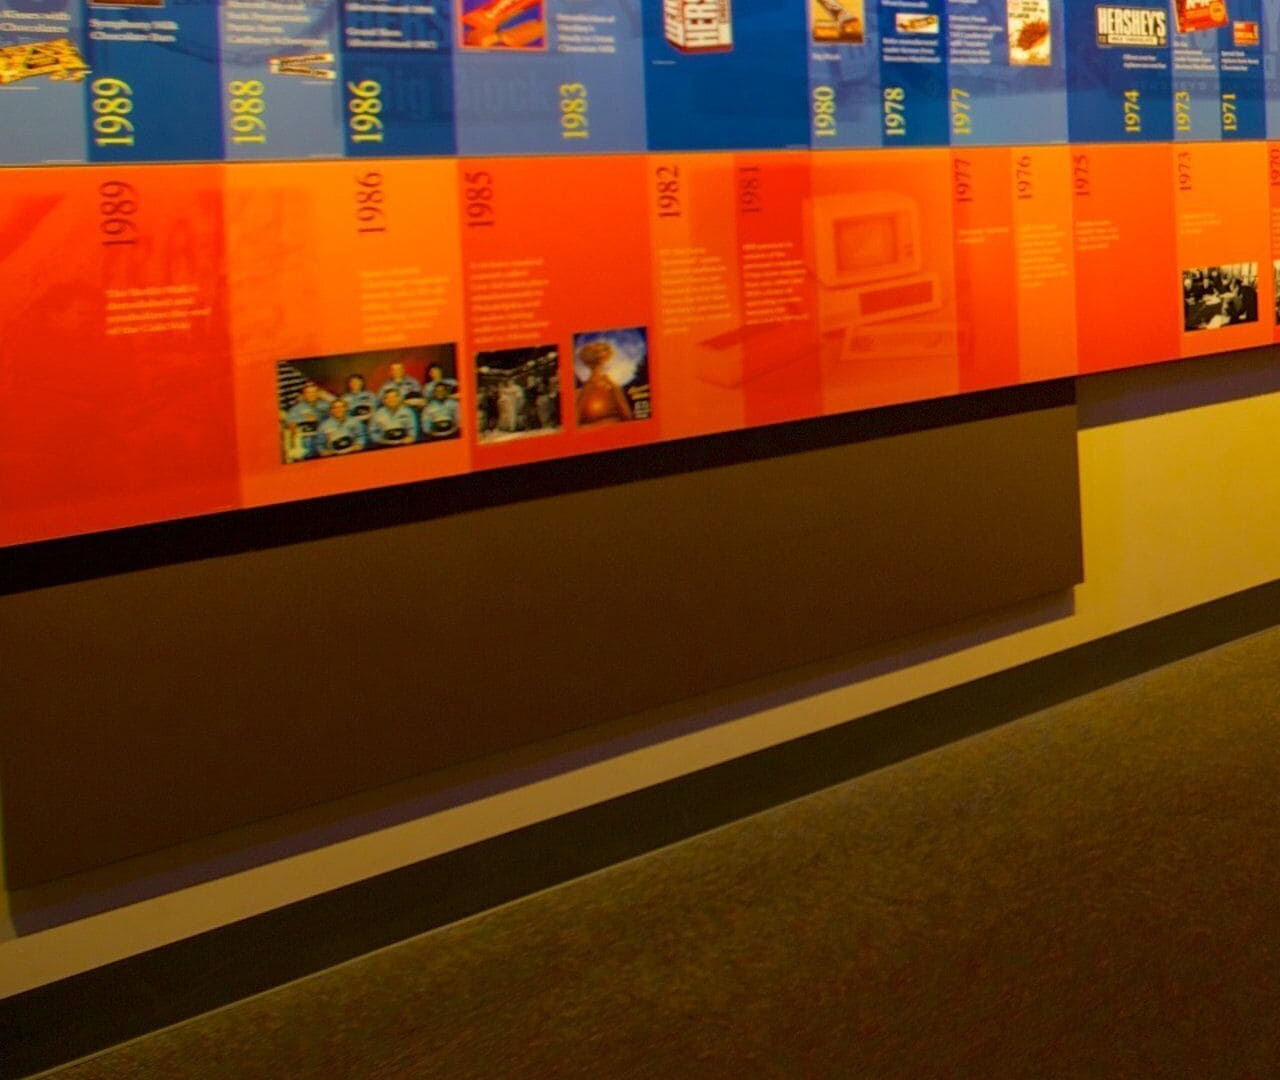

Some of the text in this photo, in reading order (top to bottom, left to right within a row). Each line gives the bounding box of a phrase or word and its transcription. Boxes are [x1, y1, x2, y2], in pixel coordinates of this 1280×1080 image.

[1097, 8, 1166, 37] HERSHEY'S
[92, 77, 134, 147] 1989
[229, 79, 266, 145] 1988
[347, 79, 383, 143] 1986
[560, 82, 589, 139] 1983
[813, 85, 836, 137] 1980
[884, 87, 906, 137] 1978
[952, 88, 971, 134] 1977
[1124, 89, 1141, 133] 1974
[1175, 90, 1192, 133] 1973
[1222, 93, 1237, 132] 1971
[656, 165, 682, 219] 1982
[740, 165, 761, 215] 1981
[955, 158, 972, 203] 1977
[1017, 155, 1033, 201] 1976
[1074, 154, 1090, 197] 1975
[1178, 151, 1192, 191] 1973
[101, 181, 137, 247] 1989
[356, 171, 386, 235] 1986
[466, 170, 494, 228] 1985
